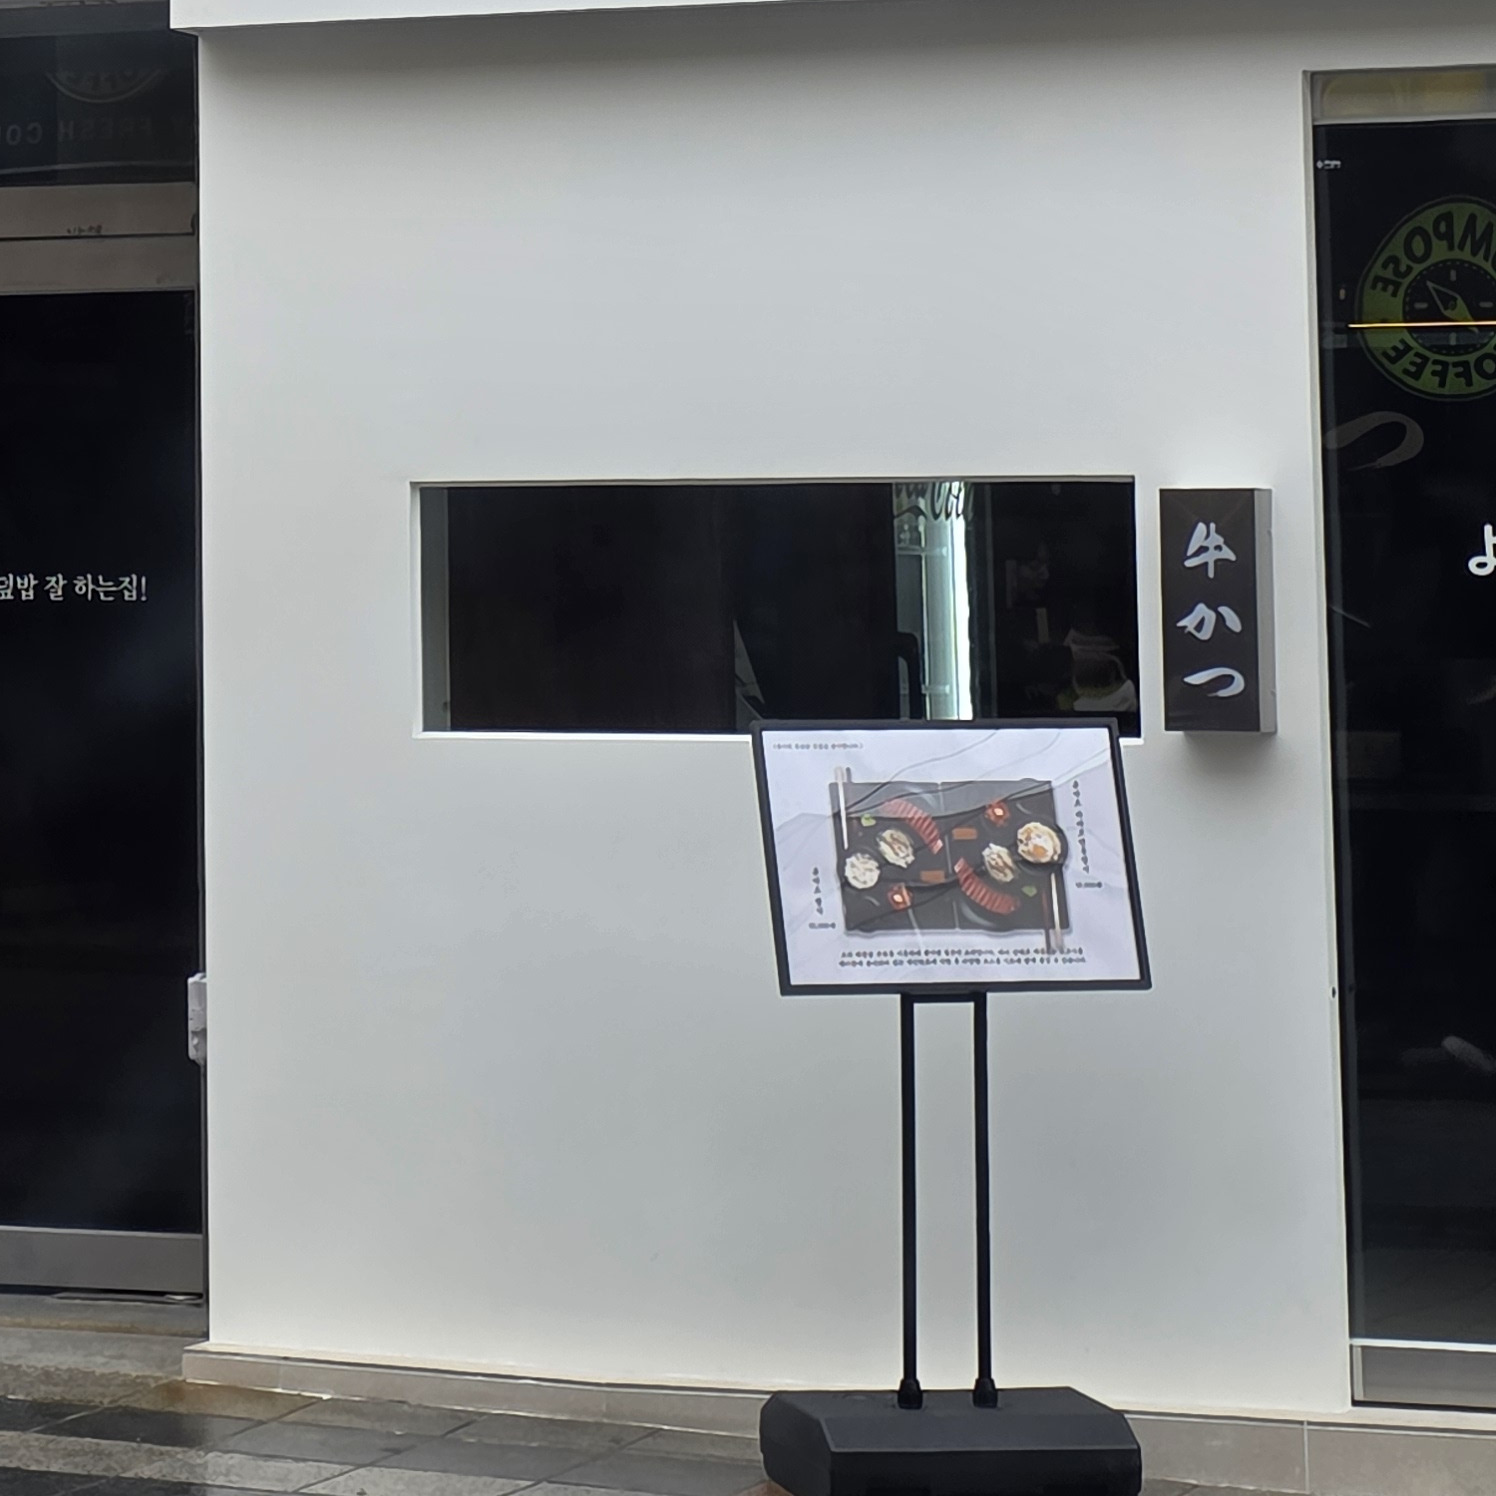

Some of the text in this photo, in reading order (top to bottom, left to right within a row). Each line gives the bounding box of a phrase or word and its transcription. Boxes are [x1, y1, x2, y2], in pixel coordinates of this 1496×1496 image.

[43, 573, 67, 601] 잘
[74, 573, 148, 601] 하는집!
[1175, 521, 1245, 698] 牛かつ
